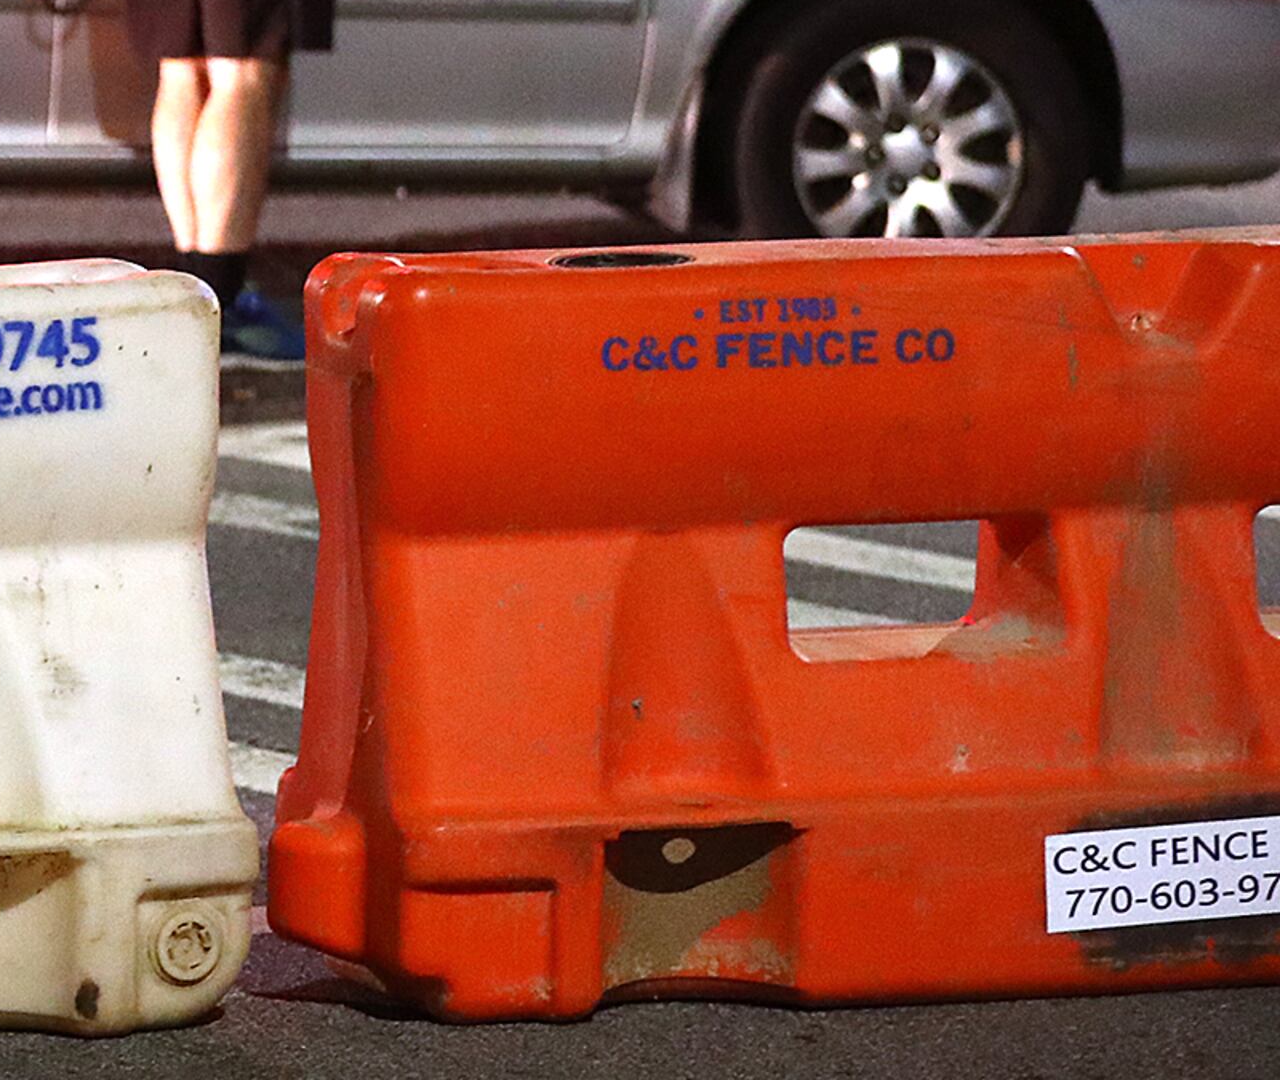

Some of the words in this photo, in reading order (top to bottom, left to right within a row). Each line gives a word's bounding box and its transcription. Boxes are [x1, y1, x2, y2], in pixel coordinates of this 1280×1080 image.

[719, 298, 767, 323] EST
[601, 334, 698, 371] C&C
[715, 329, 879, 369] FENCE
[895, 327, 955, 364] CO
[1053, 841, 1137, 875] C&C
[1151, 829, 1269, 867] FENCE
